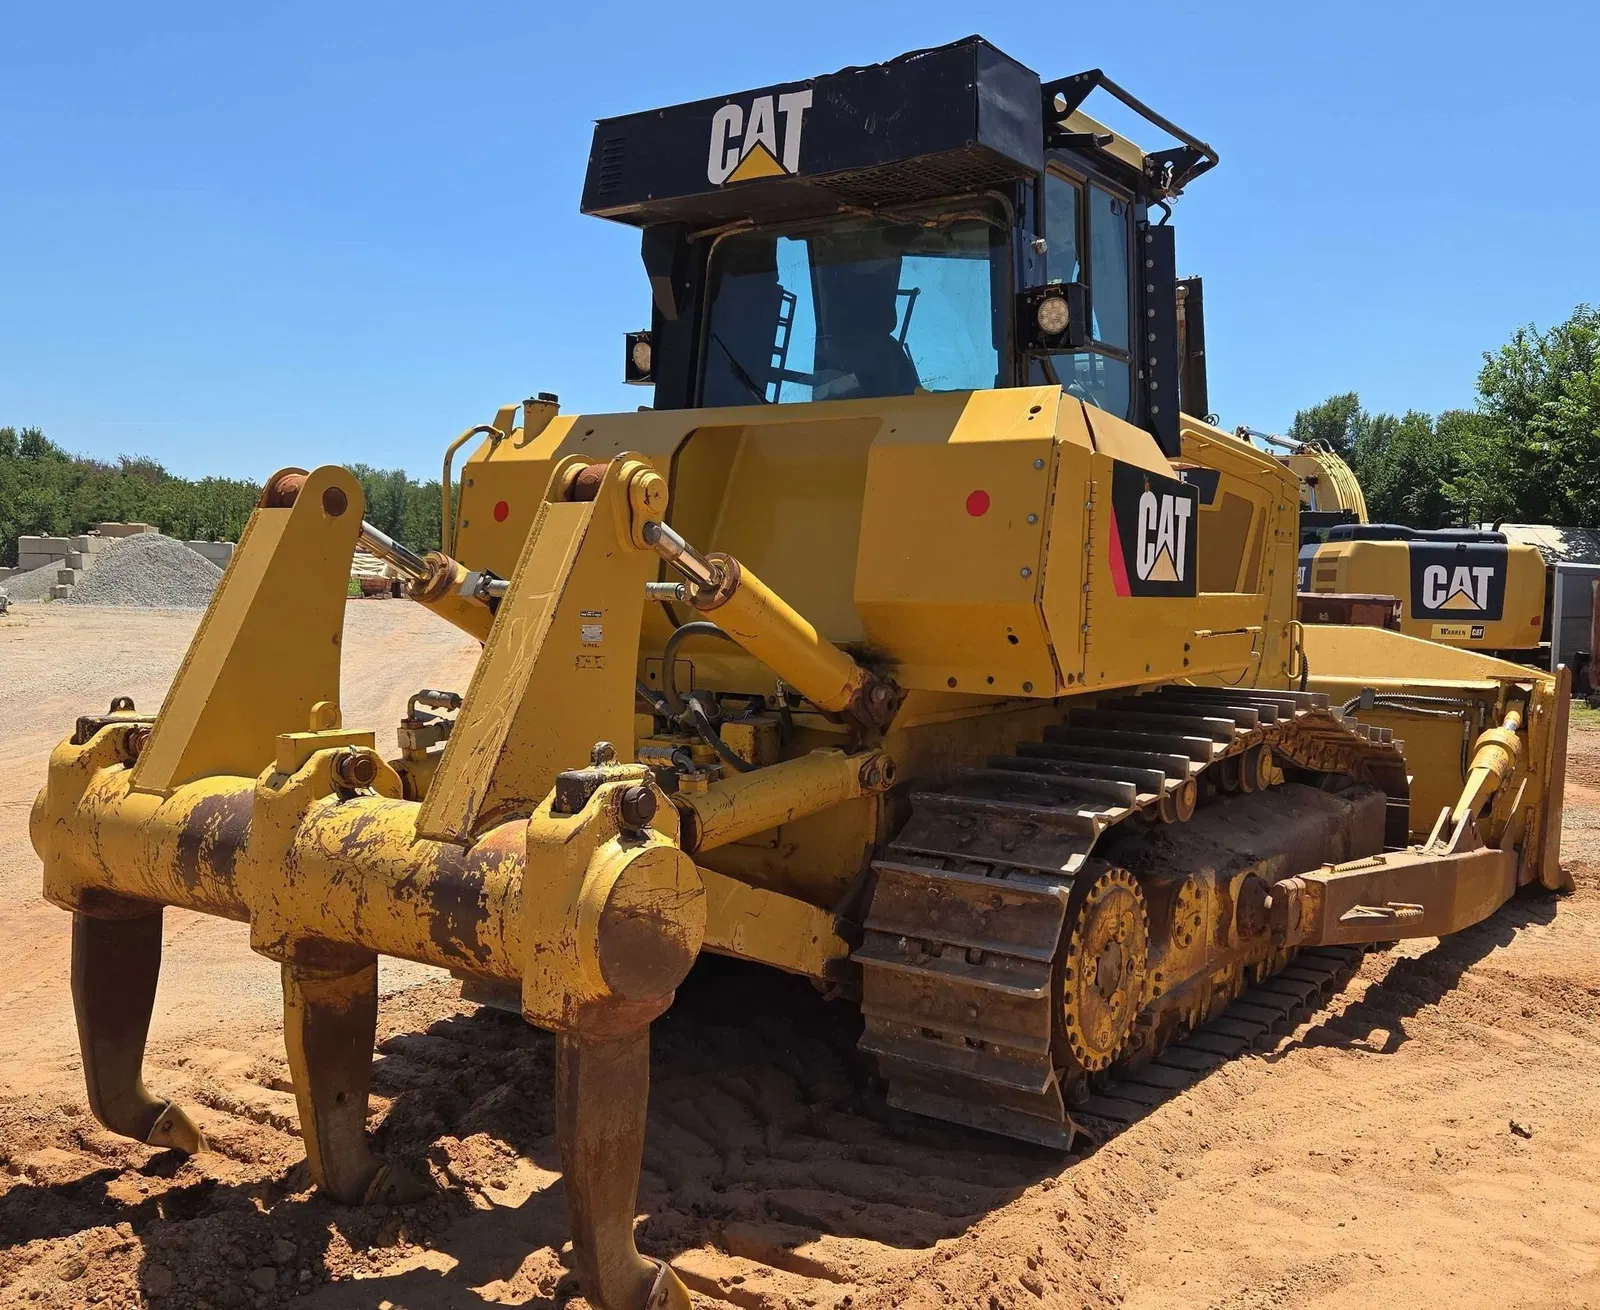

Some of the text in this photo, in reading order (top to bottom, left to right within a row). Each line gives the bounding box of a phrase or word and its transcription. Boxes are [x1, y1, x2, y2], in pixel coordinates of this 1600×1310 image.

[707, 89, 814, 185] CAT
[1136, 491, 1191, 581] CAT
[1422, 564, 1495, 611] CAT
[1440, 627, 1484, 636] WARREN CAT
